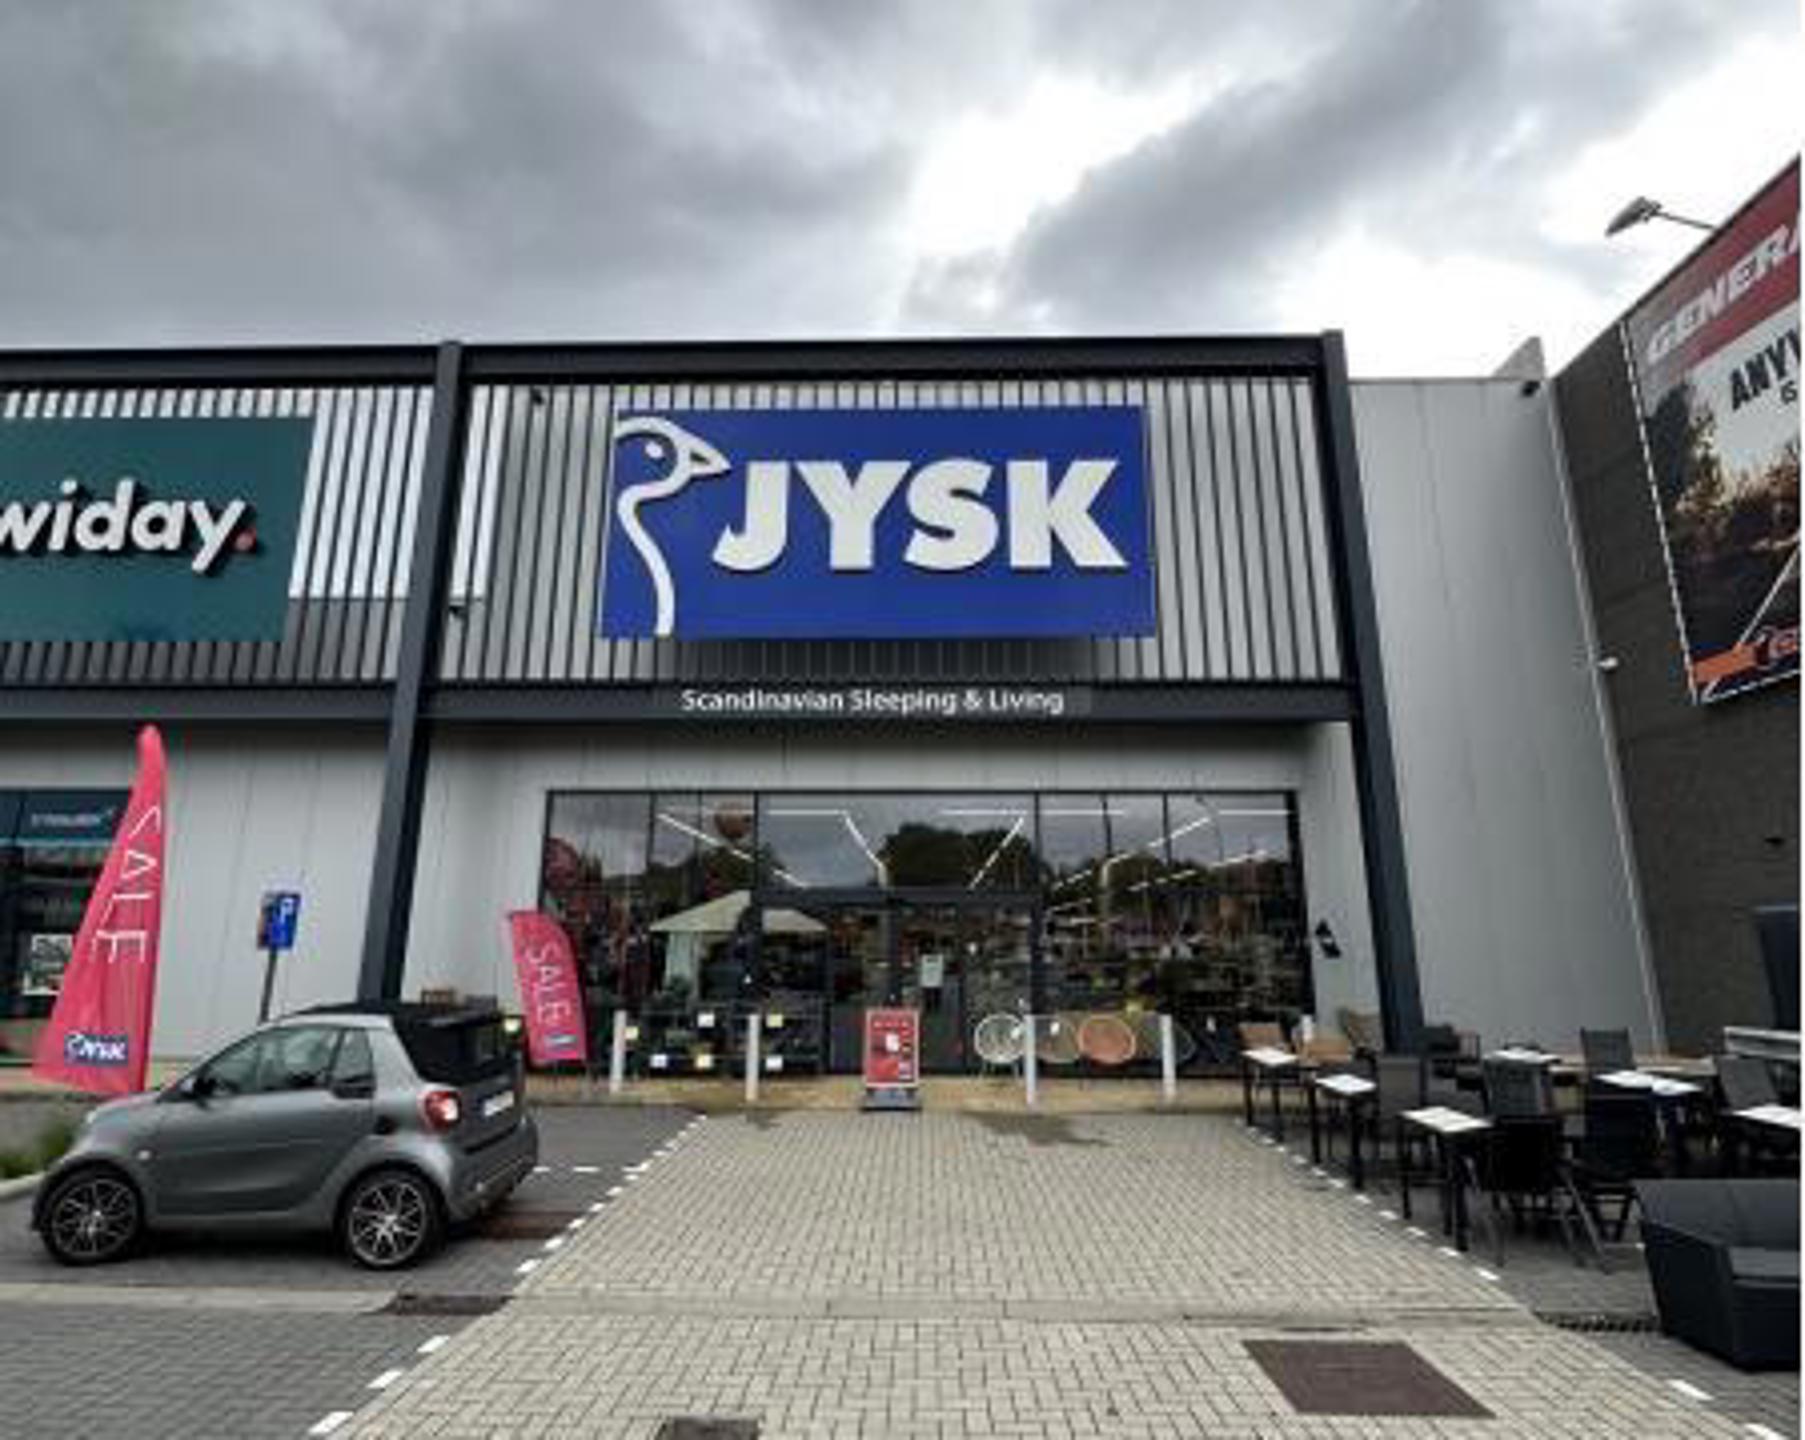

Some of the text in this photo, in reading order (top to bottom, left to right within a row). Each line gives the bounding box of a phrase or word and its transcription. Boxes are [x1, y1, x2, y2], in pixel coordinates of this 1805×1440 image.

[712, 457, 1129, 573] JYSK
[680, 688, 1065, 716] Scandinavian Sleeping & Living
[88, 805, 161, 964] SALE
[524, 941, 571, 1026] SALE
